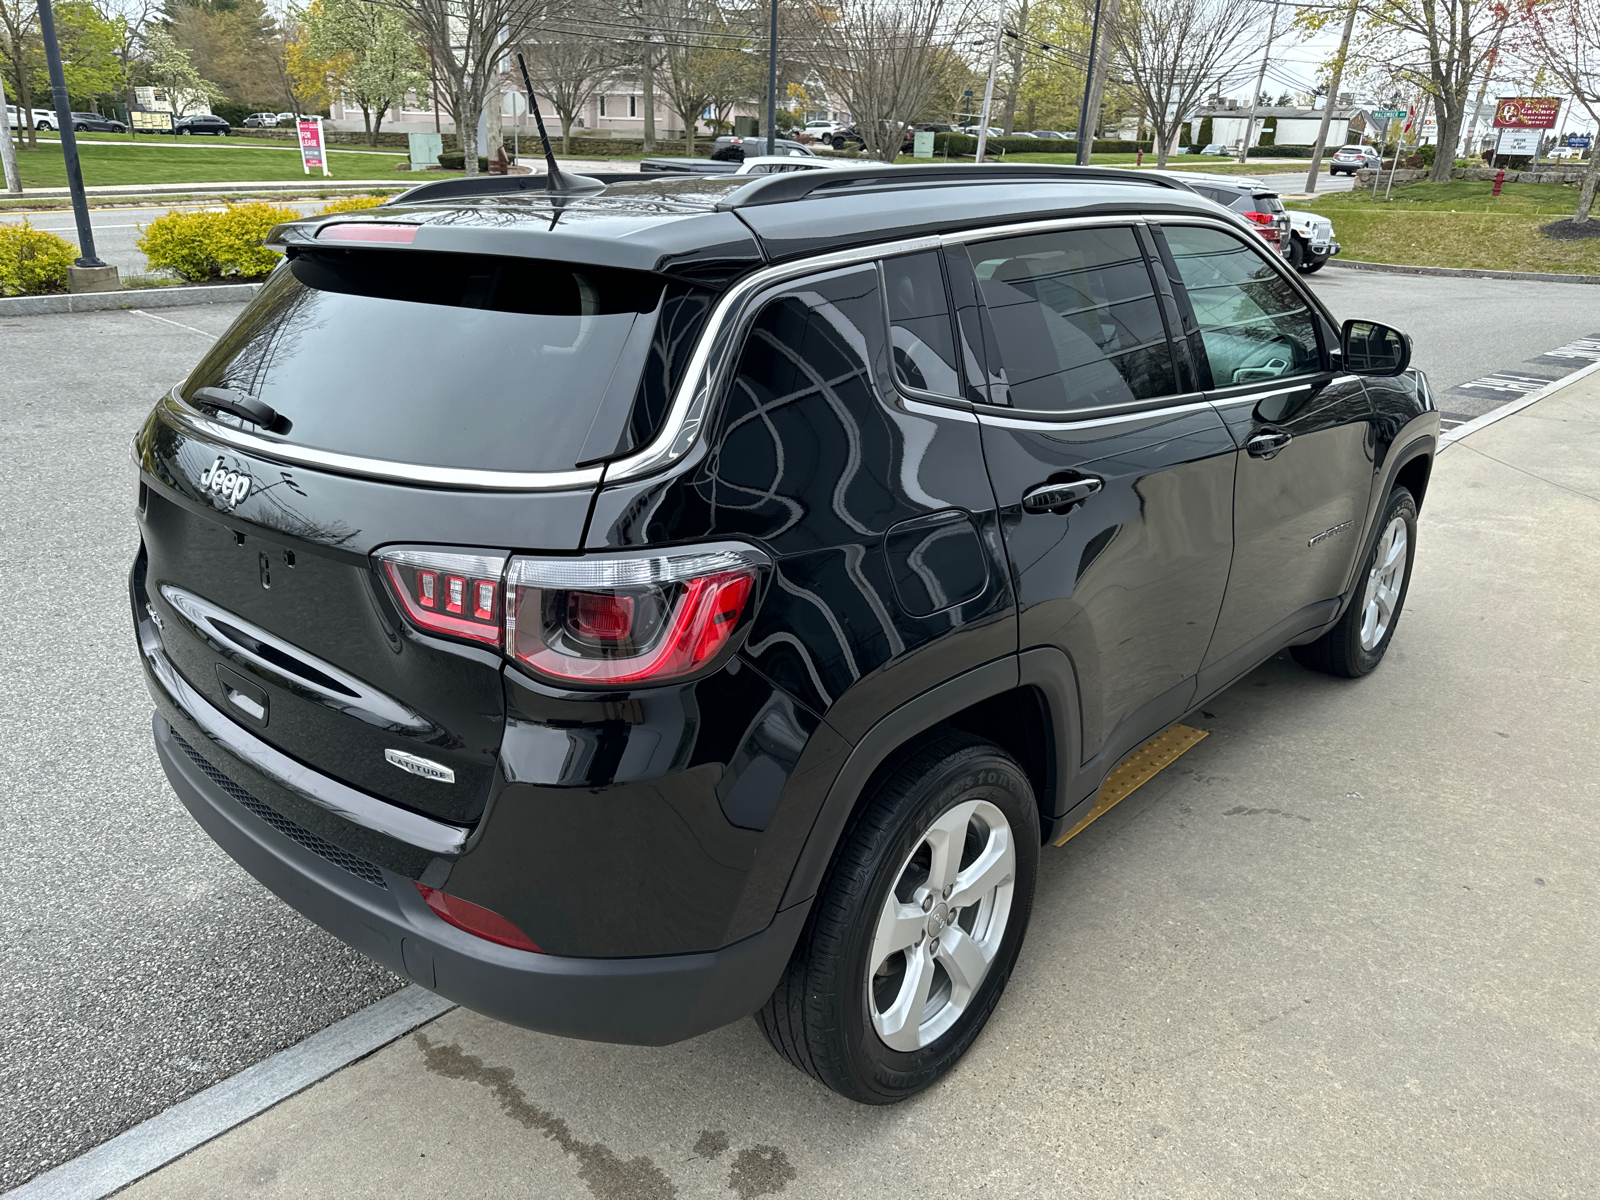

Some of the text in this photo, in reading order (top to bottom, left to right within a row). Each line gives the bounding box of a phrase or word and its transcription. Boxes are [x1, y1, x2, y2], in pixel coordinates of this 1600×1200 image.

[301, 131, 311, 139] FOR
[302, 139, 318, 147] LEASE
[200, 458, 250, 508] Jeep
[390, 755, 446, 778] LATITUDE
[915, 769, 1017, 832] Firestone
